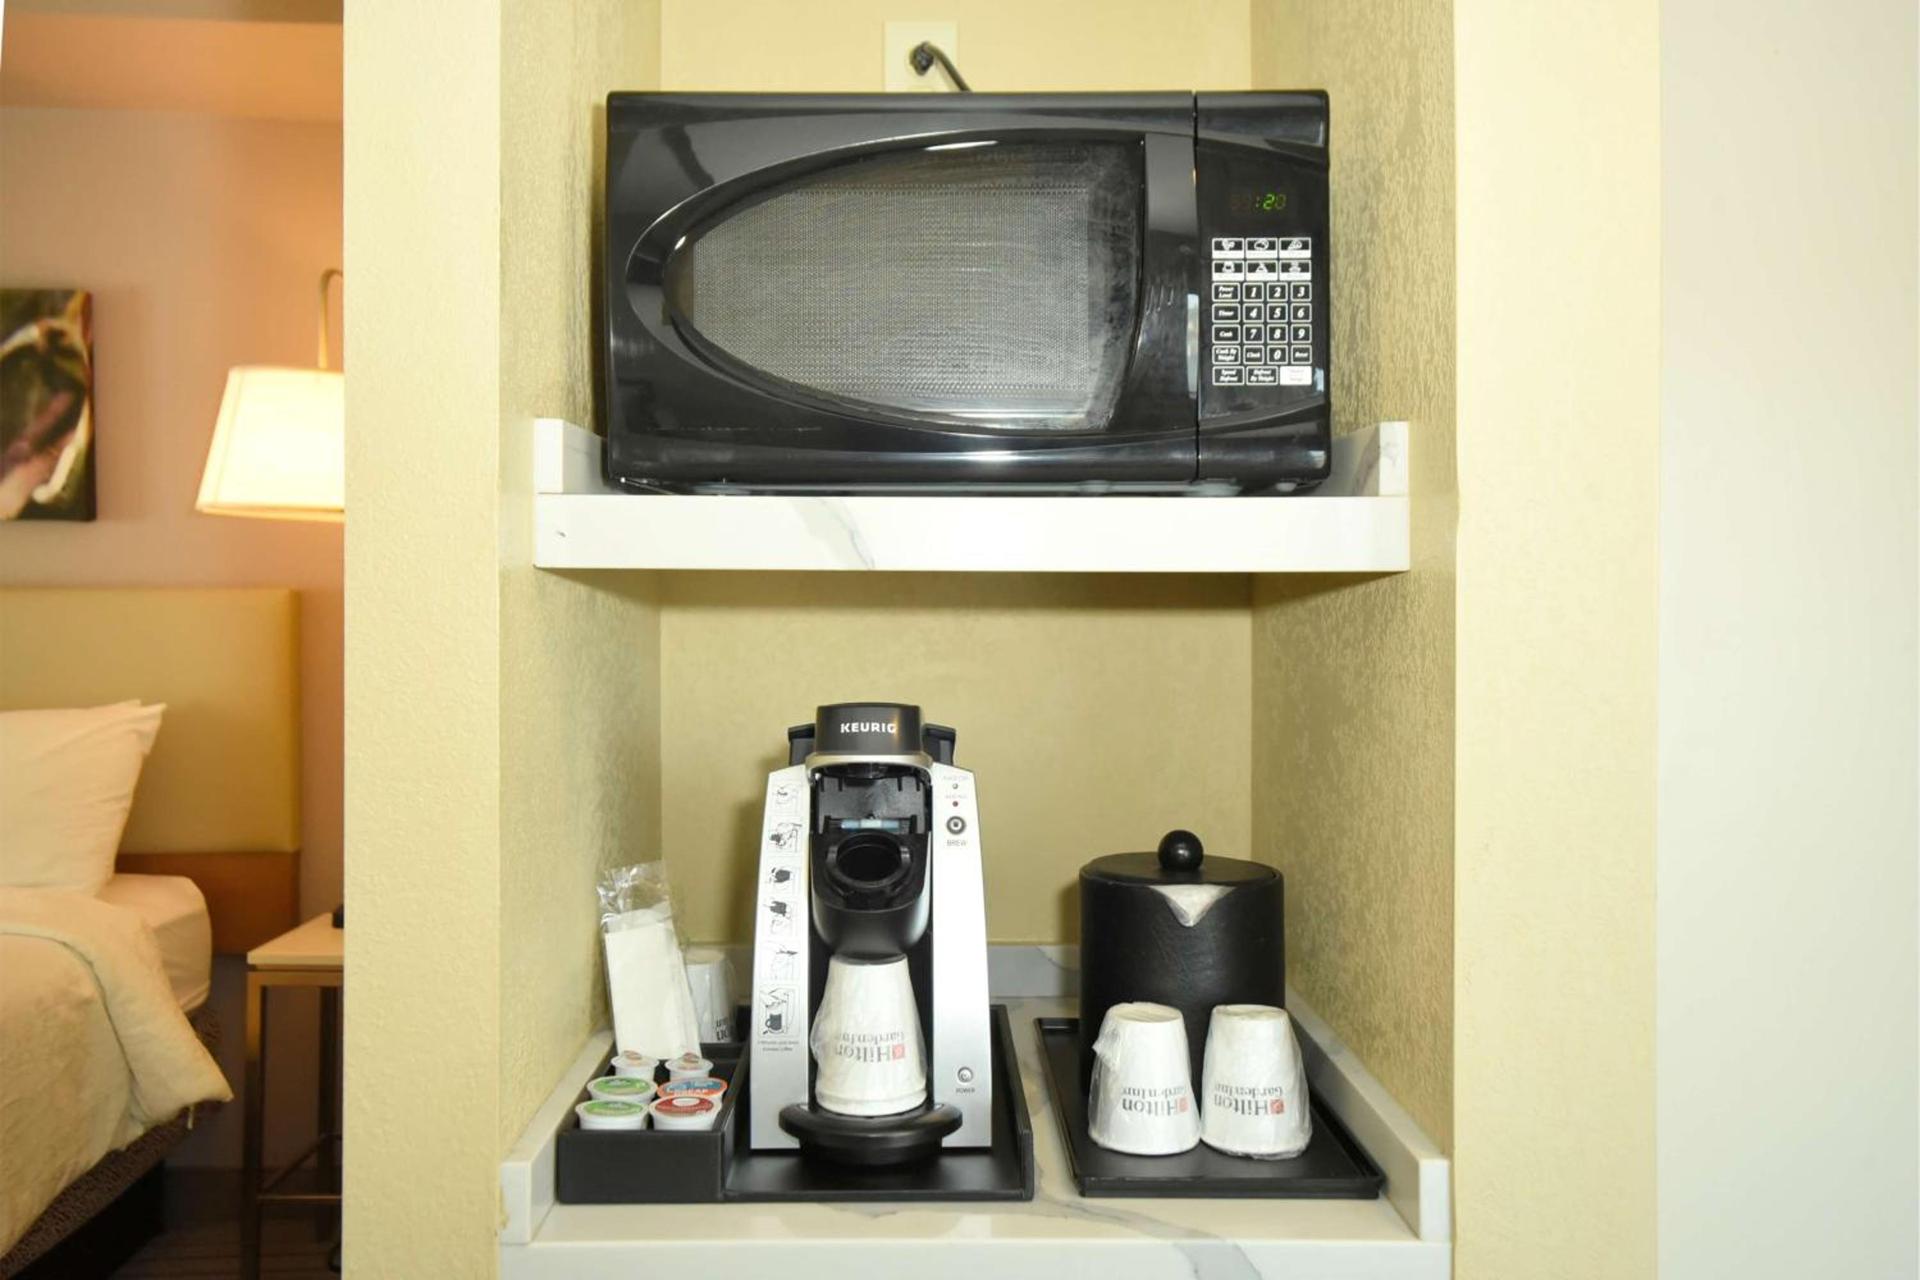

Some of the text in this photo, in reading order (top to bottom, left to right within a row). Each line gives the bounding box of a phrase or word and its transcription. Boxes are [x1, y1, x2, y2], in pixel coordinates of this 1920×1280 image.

[1250, 286, 1257, 298] 1
[1273, 286, 1281, 298] 2
[1297, 286, 1305, 298] 3
[1249, 307, 1257, 318] 4
[1273, 307, 1281, 318] 5
[1297, 307, 1305, 318] 6
[1250, 328, 1257, 339] 7
[1273, 328, 1281, 339] 8
[1297, 328, 1306, 339] 9
[1273, 349, 1281, 360] 0
[840, 722, 897, 734] KEURIG
[835, 1044, 891, 1063] Hilton
[1236, 1086, 1283, 1099] Garden
[1122, 1098, 1178, 1116] Hilton
[1214, 1094, 1268, 1116] Hilton
